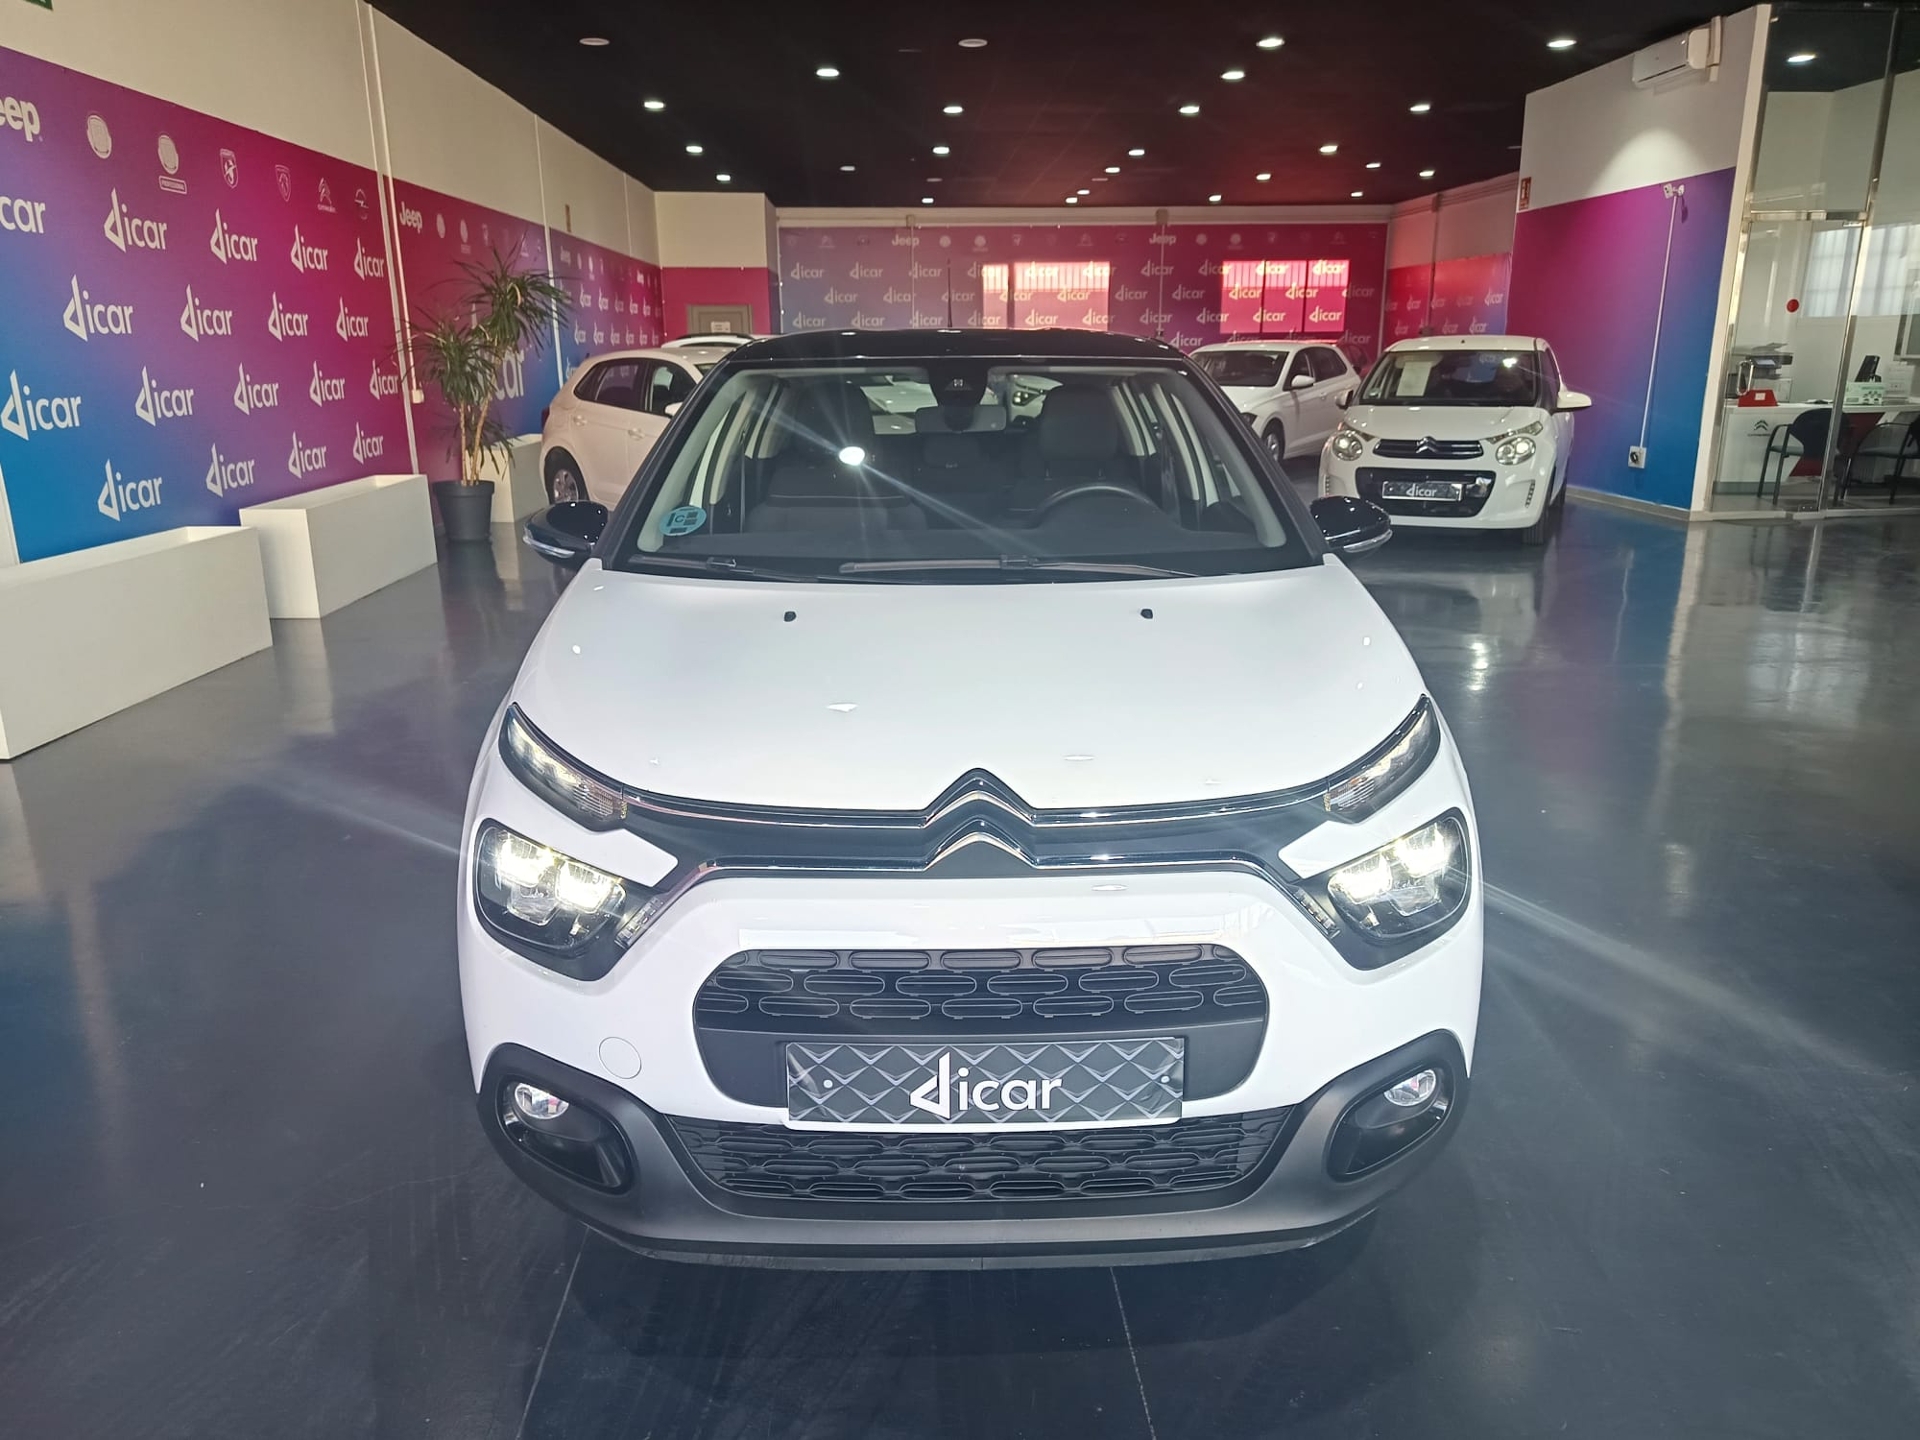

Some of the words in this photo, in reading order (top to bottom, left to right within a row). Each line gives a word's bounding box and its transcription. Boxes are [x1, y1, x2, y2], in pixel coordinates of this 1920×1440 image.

[103, 187, 168, 253] dicar
[209, 208, 259, 265] dicar
[290, 224, 329, 273] dicar
[353, 237, 385, 281] dicar
[790, 262, 825, 280] dicar
[849, 262, 884, 280] dicar
[908, 262, 943, 280] dicar
[1140, 260, 1175, 277] dicar
[824, 287, 858, 305] dicar
[883, 286, 916, 304] dicar
[1057, 285, 1090, 303] dicar
[1115, 285, 1148, 301] dicar
[1172, 284, 1206, 300] dicar
[1228, 282, 1263, 300] dicar
[1285, 282, 1319, 299] dicar
[62, 274, 134, 342] dicar
[180, 283, 233, 342] dicar
[267, 291, 309, 342] dicar
[1139, 308, 1173, 325] dicar
[1196, 307, 1230, 325] dicar
[1253, 307, 1286, 324] dicar
[1309, 306, 1343, 323] dicar
[335, 296, 369, 342] dicar
[792, 311, 827, 329] dicar
[851, 311, 885, 329] dicar
[909, 310, 944, 329] dicar
[967, 310, 1002, 328] dicar
[1025, 309, 1059, 327] dicar
[1082, 309, 1116, 327] dicar
[1170, 331, 1204, 348] dicar
[308, 360, 346, 407] dicar
[369, 358, 399, 400] dicar
[135, 365, 194, 427] dicar
[233, 362, 280, 416] dicar
[0, 369, 82, 441] dicar
[352, 421, 384, 465] dicar
[287, 431, 328, 479] dicar
[205, 442, 255, 498] dicar
[97, 458, 163, 522] dicar
[1406, 483, 1437, 499] dicar
[909, 1051, 1063, 1120] dicar
